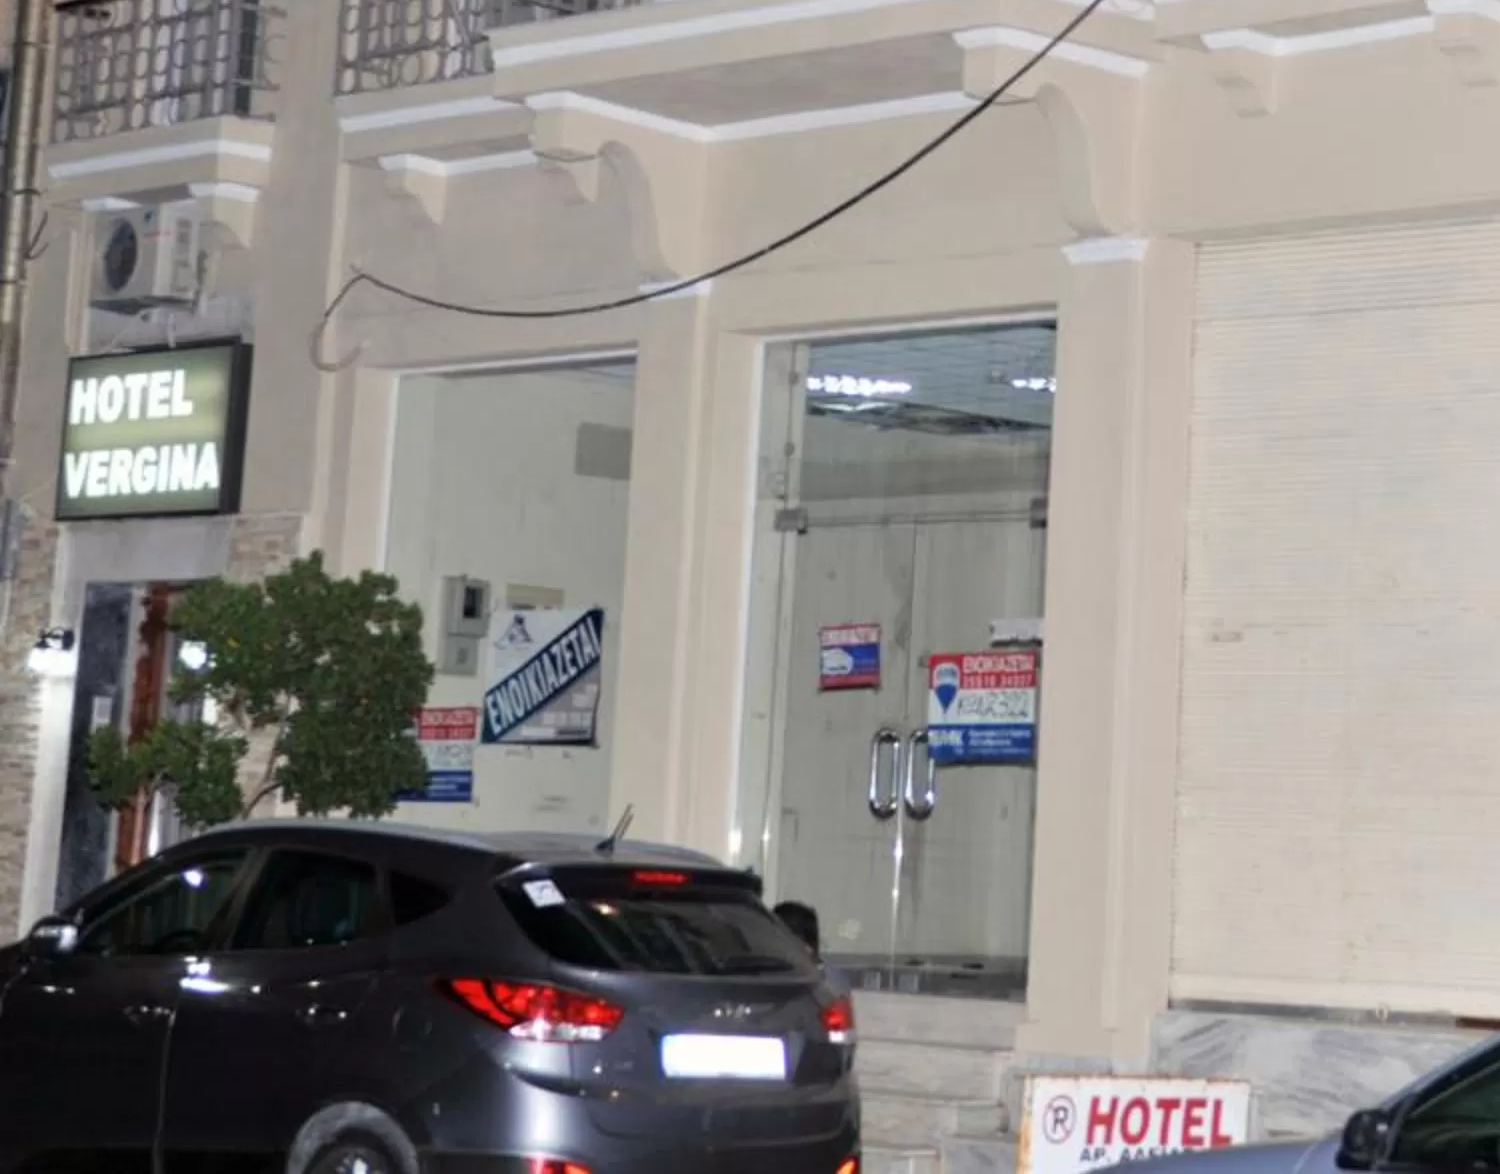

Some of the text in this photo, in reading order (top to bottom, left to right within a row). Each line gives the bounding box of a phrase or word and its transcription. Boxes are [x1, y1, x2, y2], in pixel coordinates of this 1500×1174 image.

[68, 369, 193, 425] HOTEL
[64, 441, 220, 499] VERGINA
[486, 615, 601, 736] ΕΝΟΙΚΙΑΖΕΤΑΙ
[1085, 1095, 1232, 1147] HOTEL
